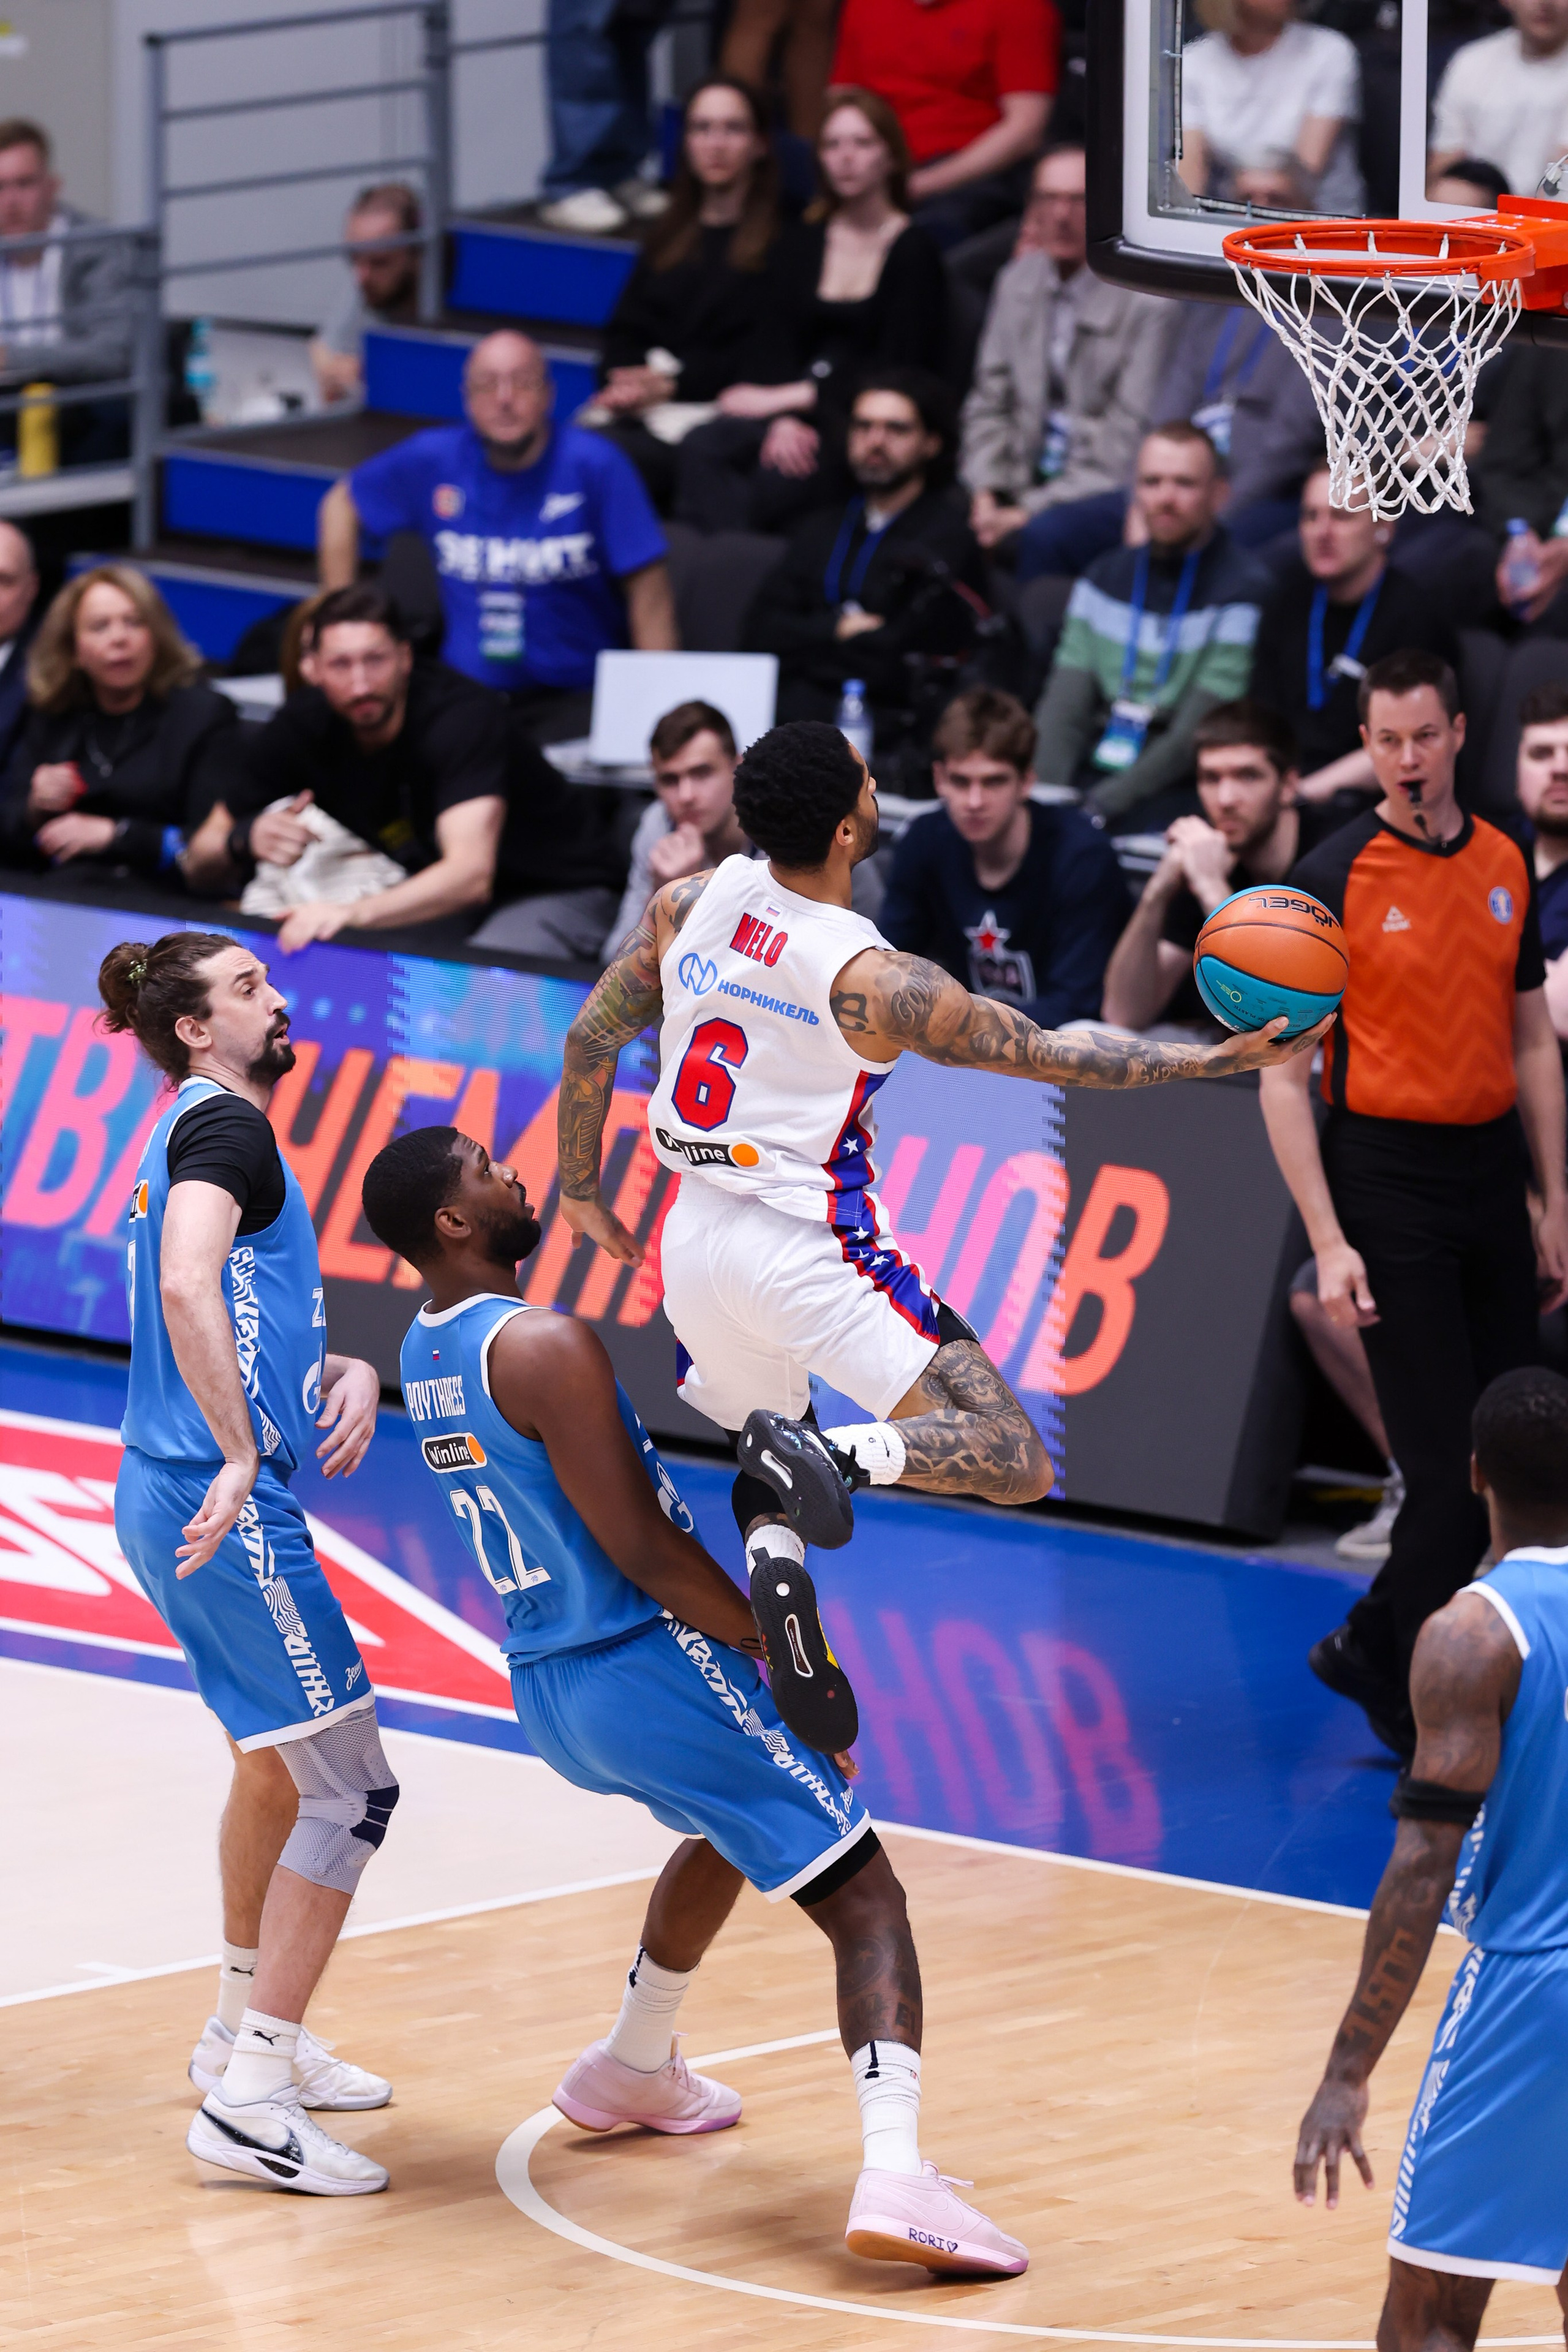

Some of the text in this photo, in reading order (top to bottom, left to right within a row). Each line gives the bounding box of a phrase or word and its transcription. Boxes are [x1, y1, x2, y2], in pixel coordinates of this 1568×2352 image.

[729, 912, 789, 968] MELO
[717, 979, 820, 1027] НОРНИКЕЛЬ
[671, 1016, 749, 1133] 6
[404, 1374, 467, 1422] POYTHRESS
[427, 1442, 470, 1465] Winline
[450, 1485, 552, 1595] 22
[908, 2227, 945, 2251] RORI
